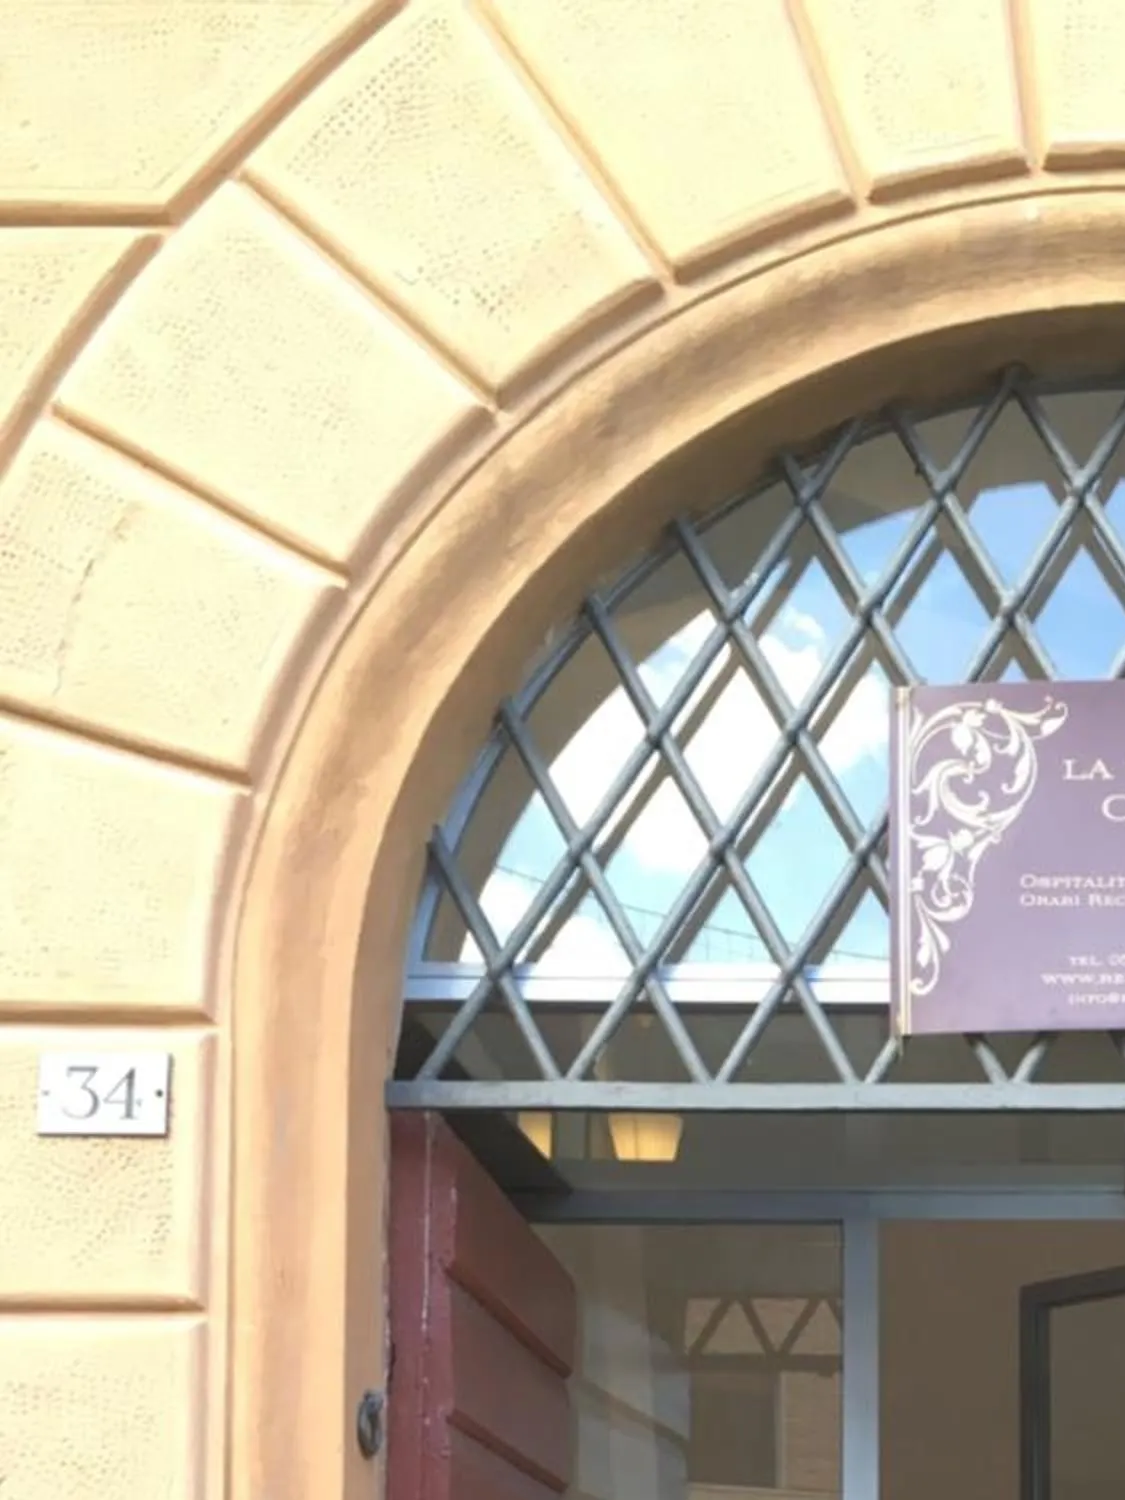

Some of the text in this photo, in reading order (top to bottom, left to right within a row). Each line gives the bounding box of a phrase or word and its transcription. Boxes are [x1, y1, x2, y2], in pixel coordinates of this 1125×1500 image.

[1062, 758, 1115, 781] LA
[1019, 892, 1080, 907] ORARI
[60, 1065, 143, 1121] 34
